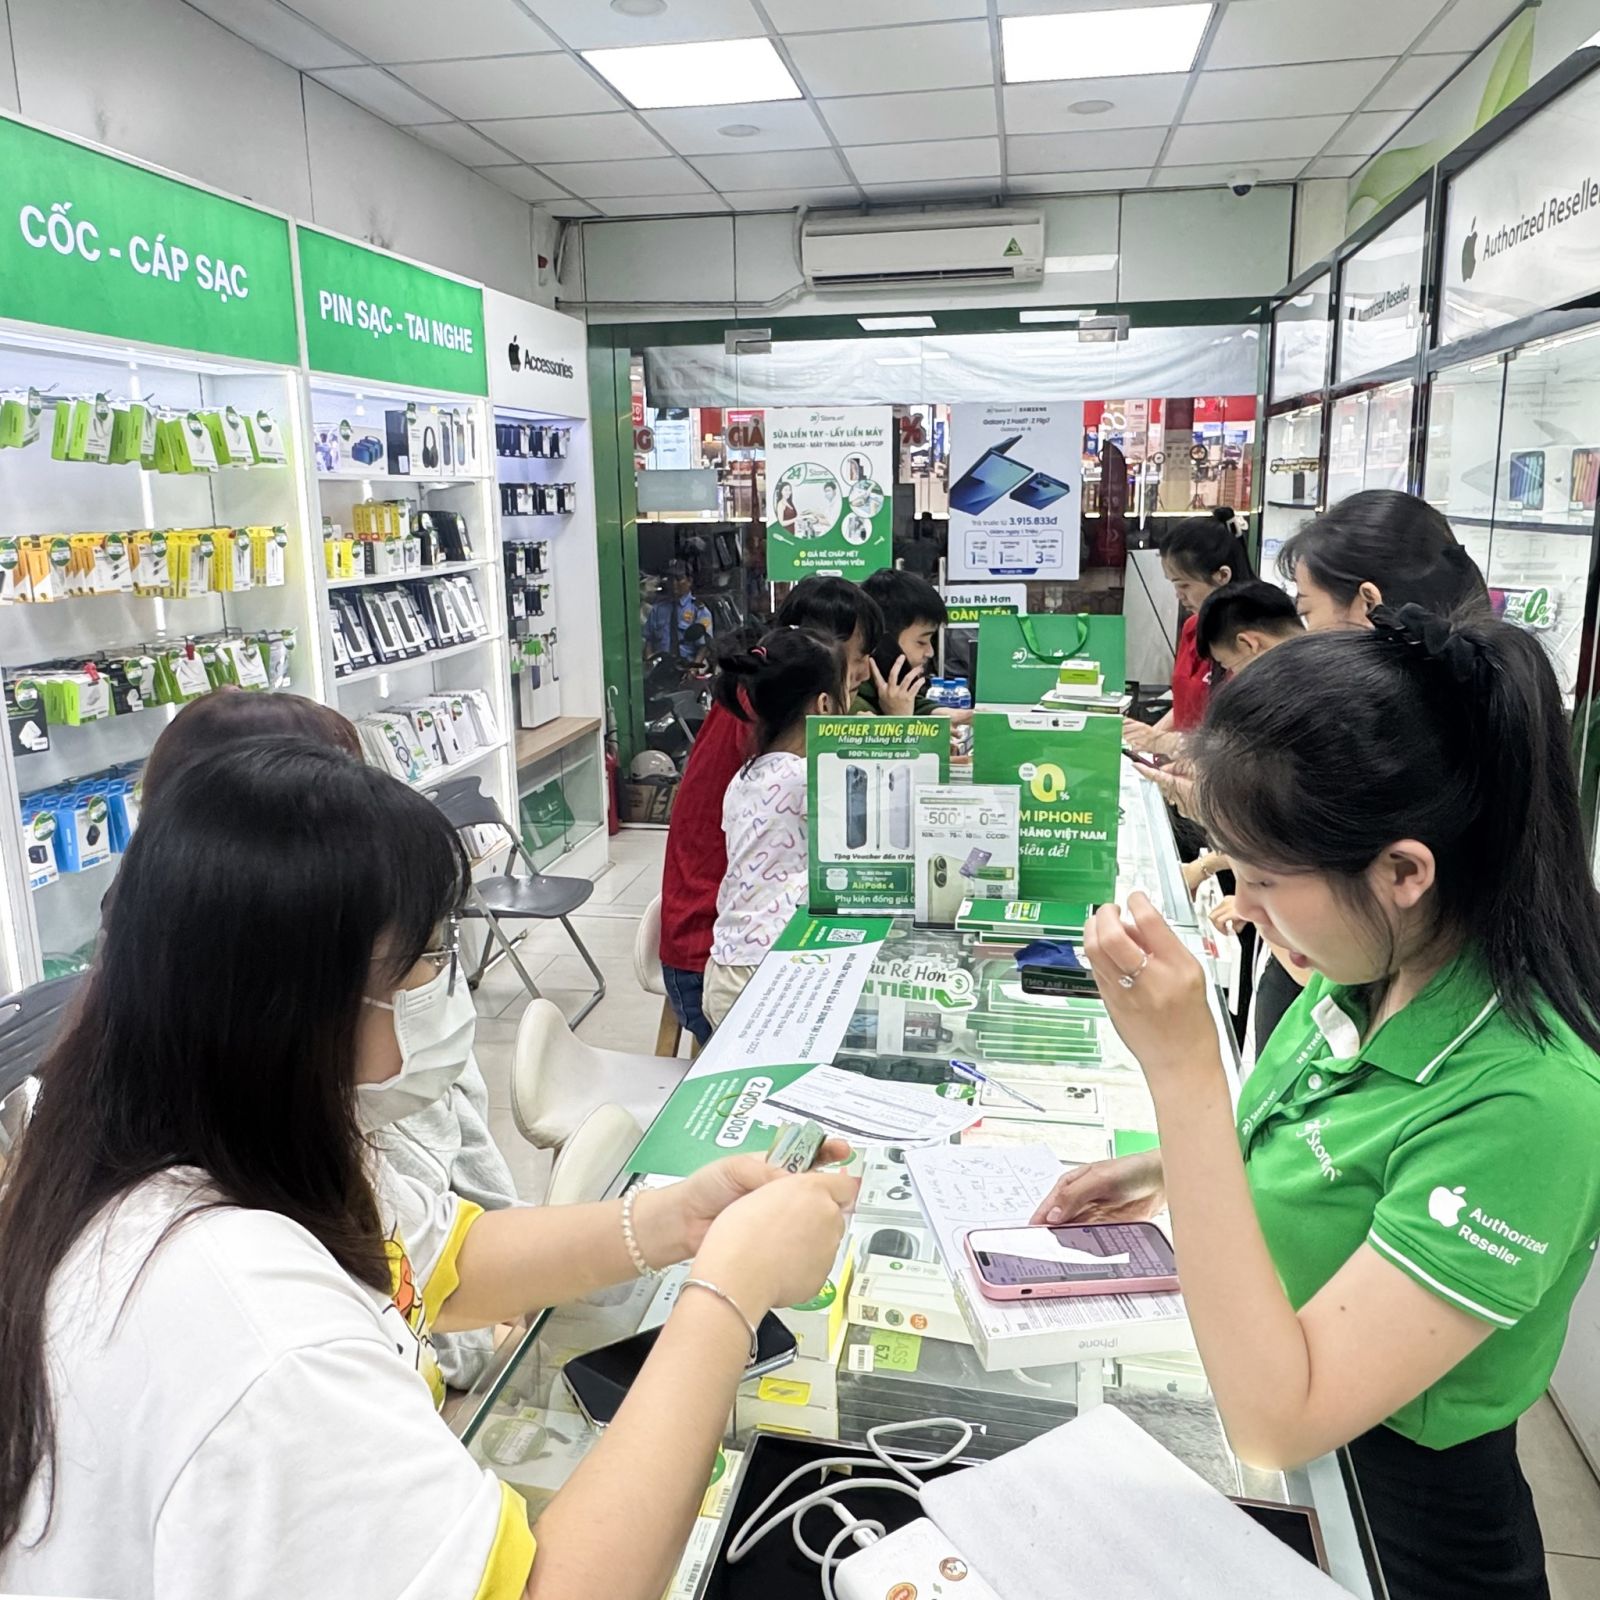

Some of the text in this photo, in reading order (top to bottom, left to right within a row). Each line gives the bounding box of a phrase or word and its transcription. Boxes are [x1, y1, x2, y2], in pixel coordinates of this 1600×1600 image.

[1483, 201, 1546, 261] Authorized
[20, 202, 248, 303] CỐC - CÁP SẠC
[319, 290, 352, 325] PIN
[357, 300, 393, 338] SẠC
[405, 313, 429, 343] TAI
[433, 321, 473, 353] NGHE
[524, 349, 574, 379] Accessories
[809, 430, 824, 438] TAY
[1035, 551, 1044, 564] 3
[990, 594, 1011, 603] Hơn
[818, 723, 870, 737] VOUCHER
[1033, 810, 1094, 824] IPHONE
[1054, 828, 1079, 841] VIỆT
[1080, 830, 1107, 840] NAM
[834, 894, 852, 904] Phụ
[852, 895, 871, 903] kiện
[890, 962, 911, 978] Rẻ
[914, 965, 947, 982] Hơn
[877, 979, 927, 1001] TIỀN
[1469, 1207, 1549, 1255] Authorized
[1458, 1224, 1522, 1266] Reseller
[1079, 1338, 1119, 1350] iPhone
